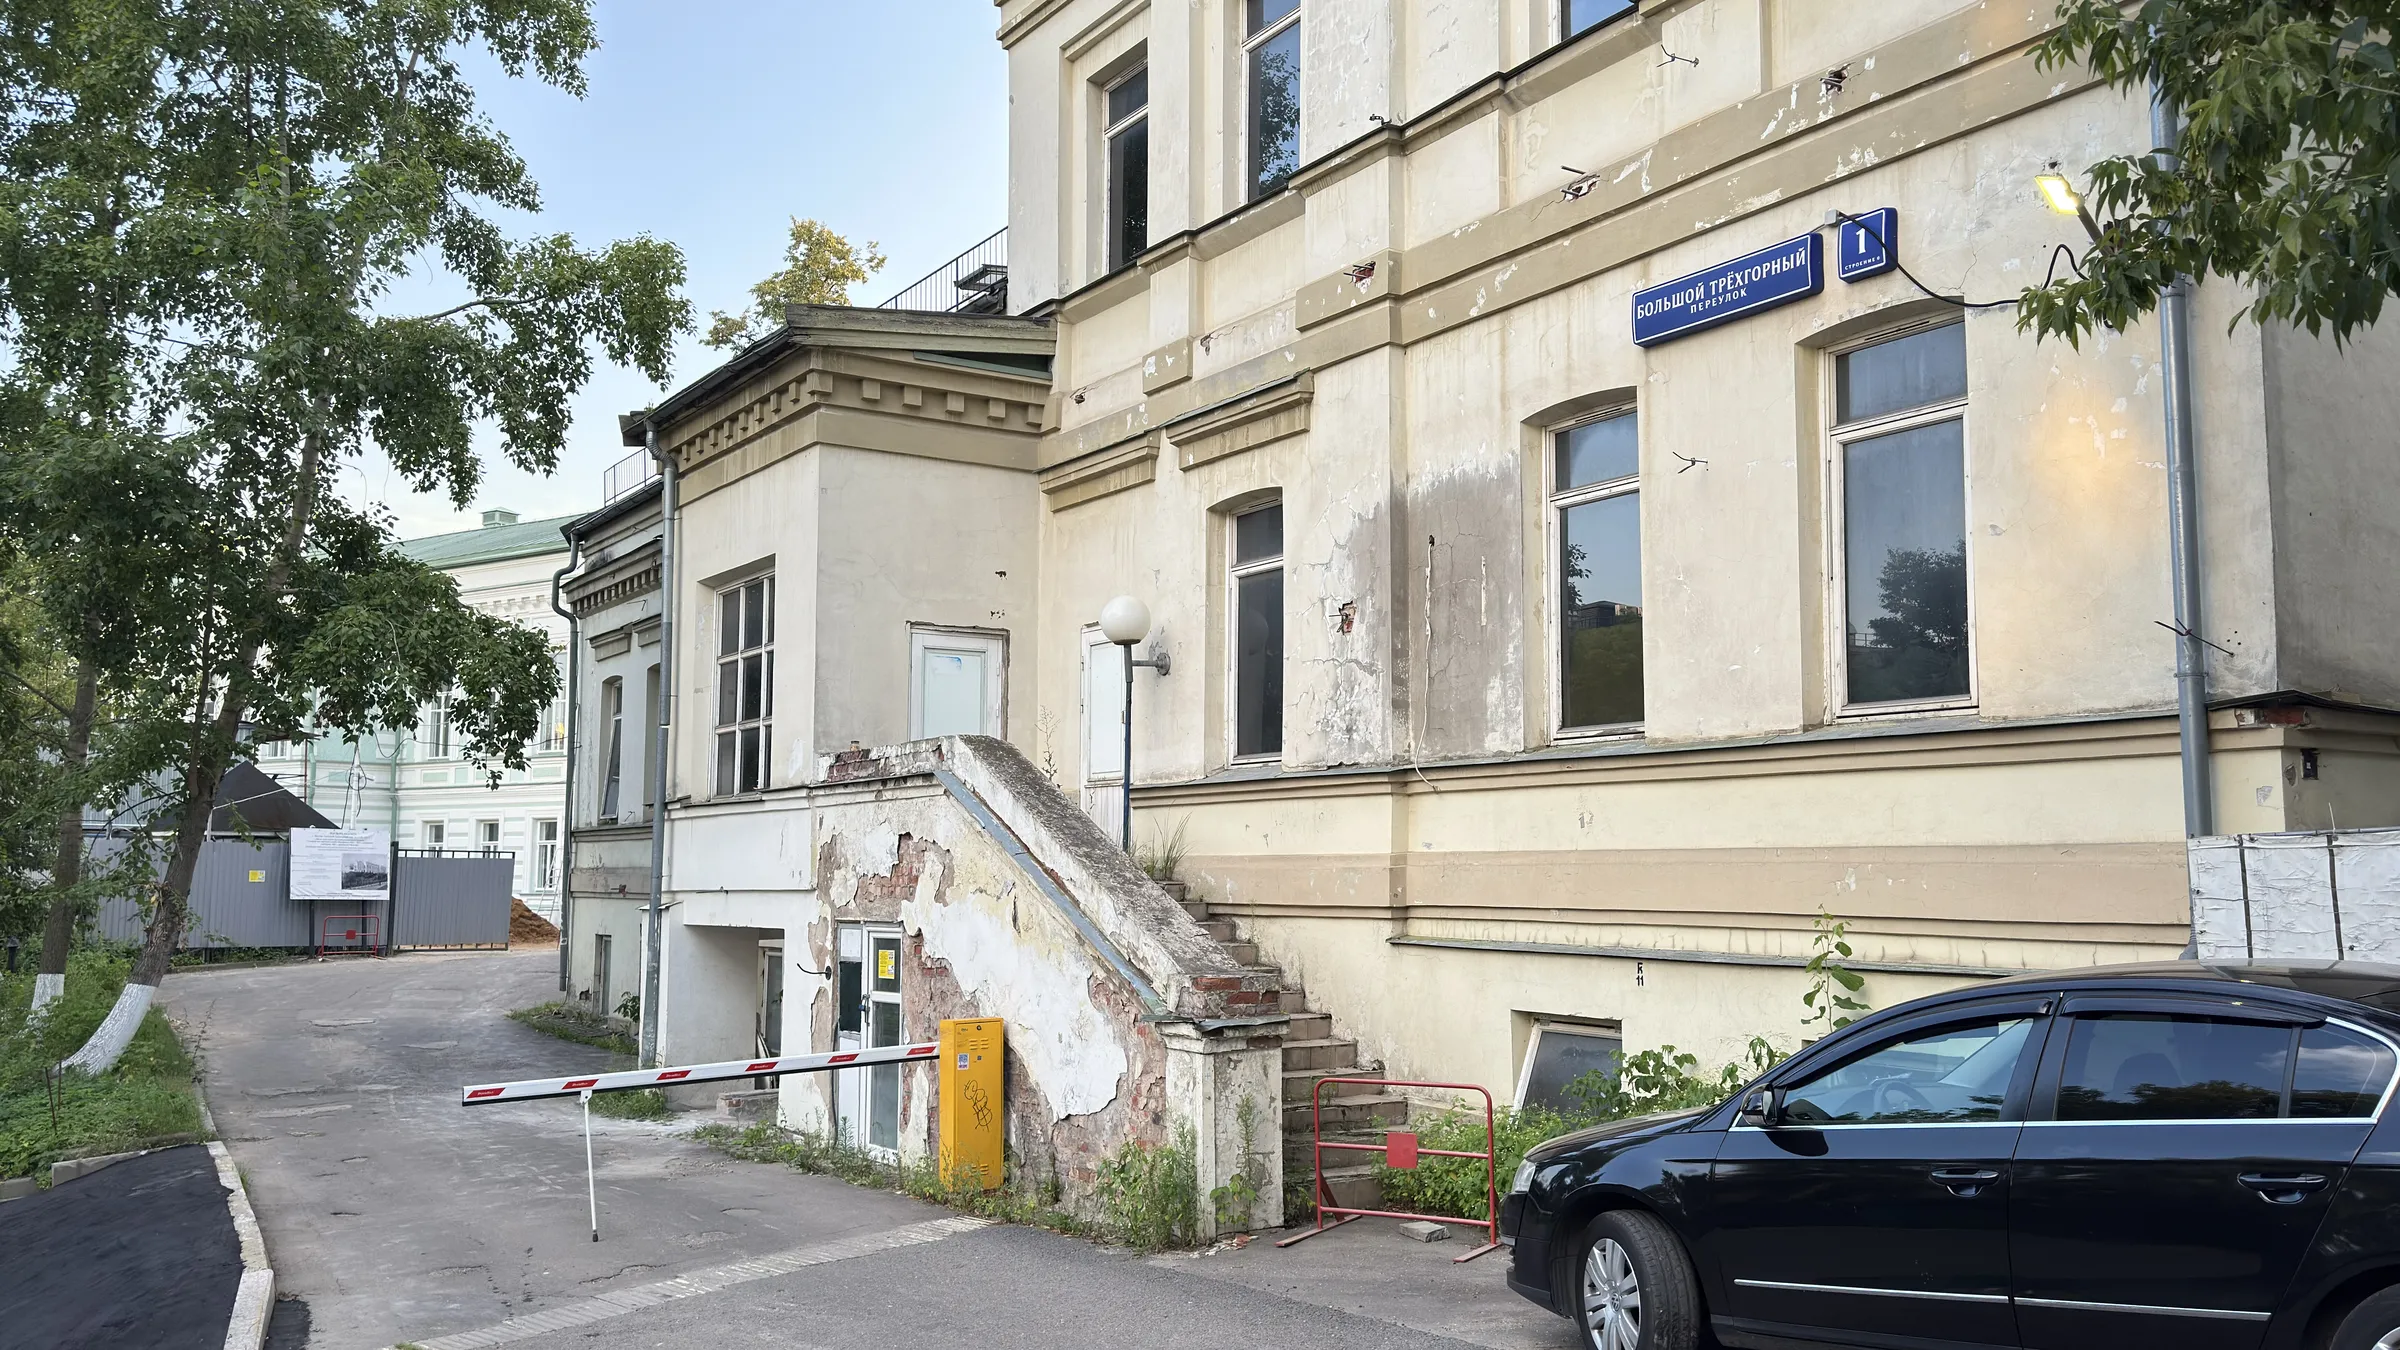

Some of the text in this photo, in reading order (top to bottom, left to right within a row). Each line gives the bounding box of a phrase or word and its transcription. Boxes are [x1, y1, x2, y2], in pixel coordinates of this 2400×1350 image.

[1855, 227, 1867, 255] 1
[1844, 256, 1876, 271] СТРОЕНИЕ
[1636, 246, 1807, 320] БОЛЬШОЙ ТРЁХГОРНЫЙ
[1690, 287, 1748, 314] ПЕРЕУЛОК
